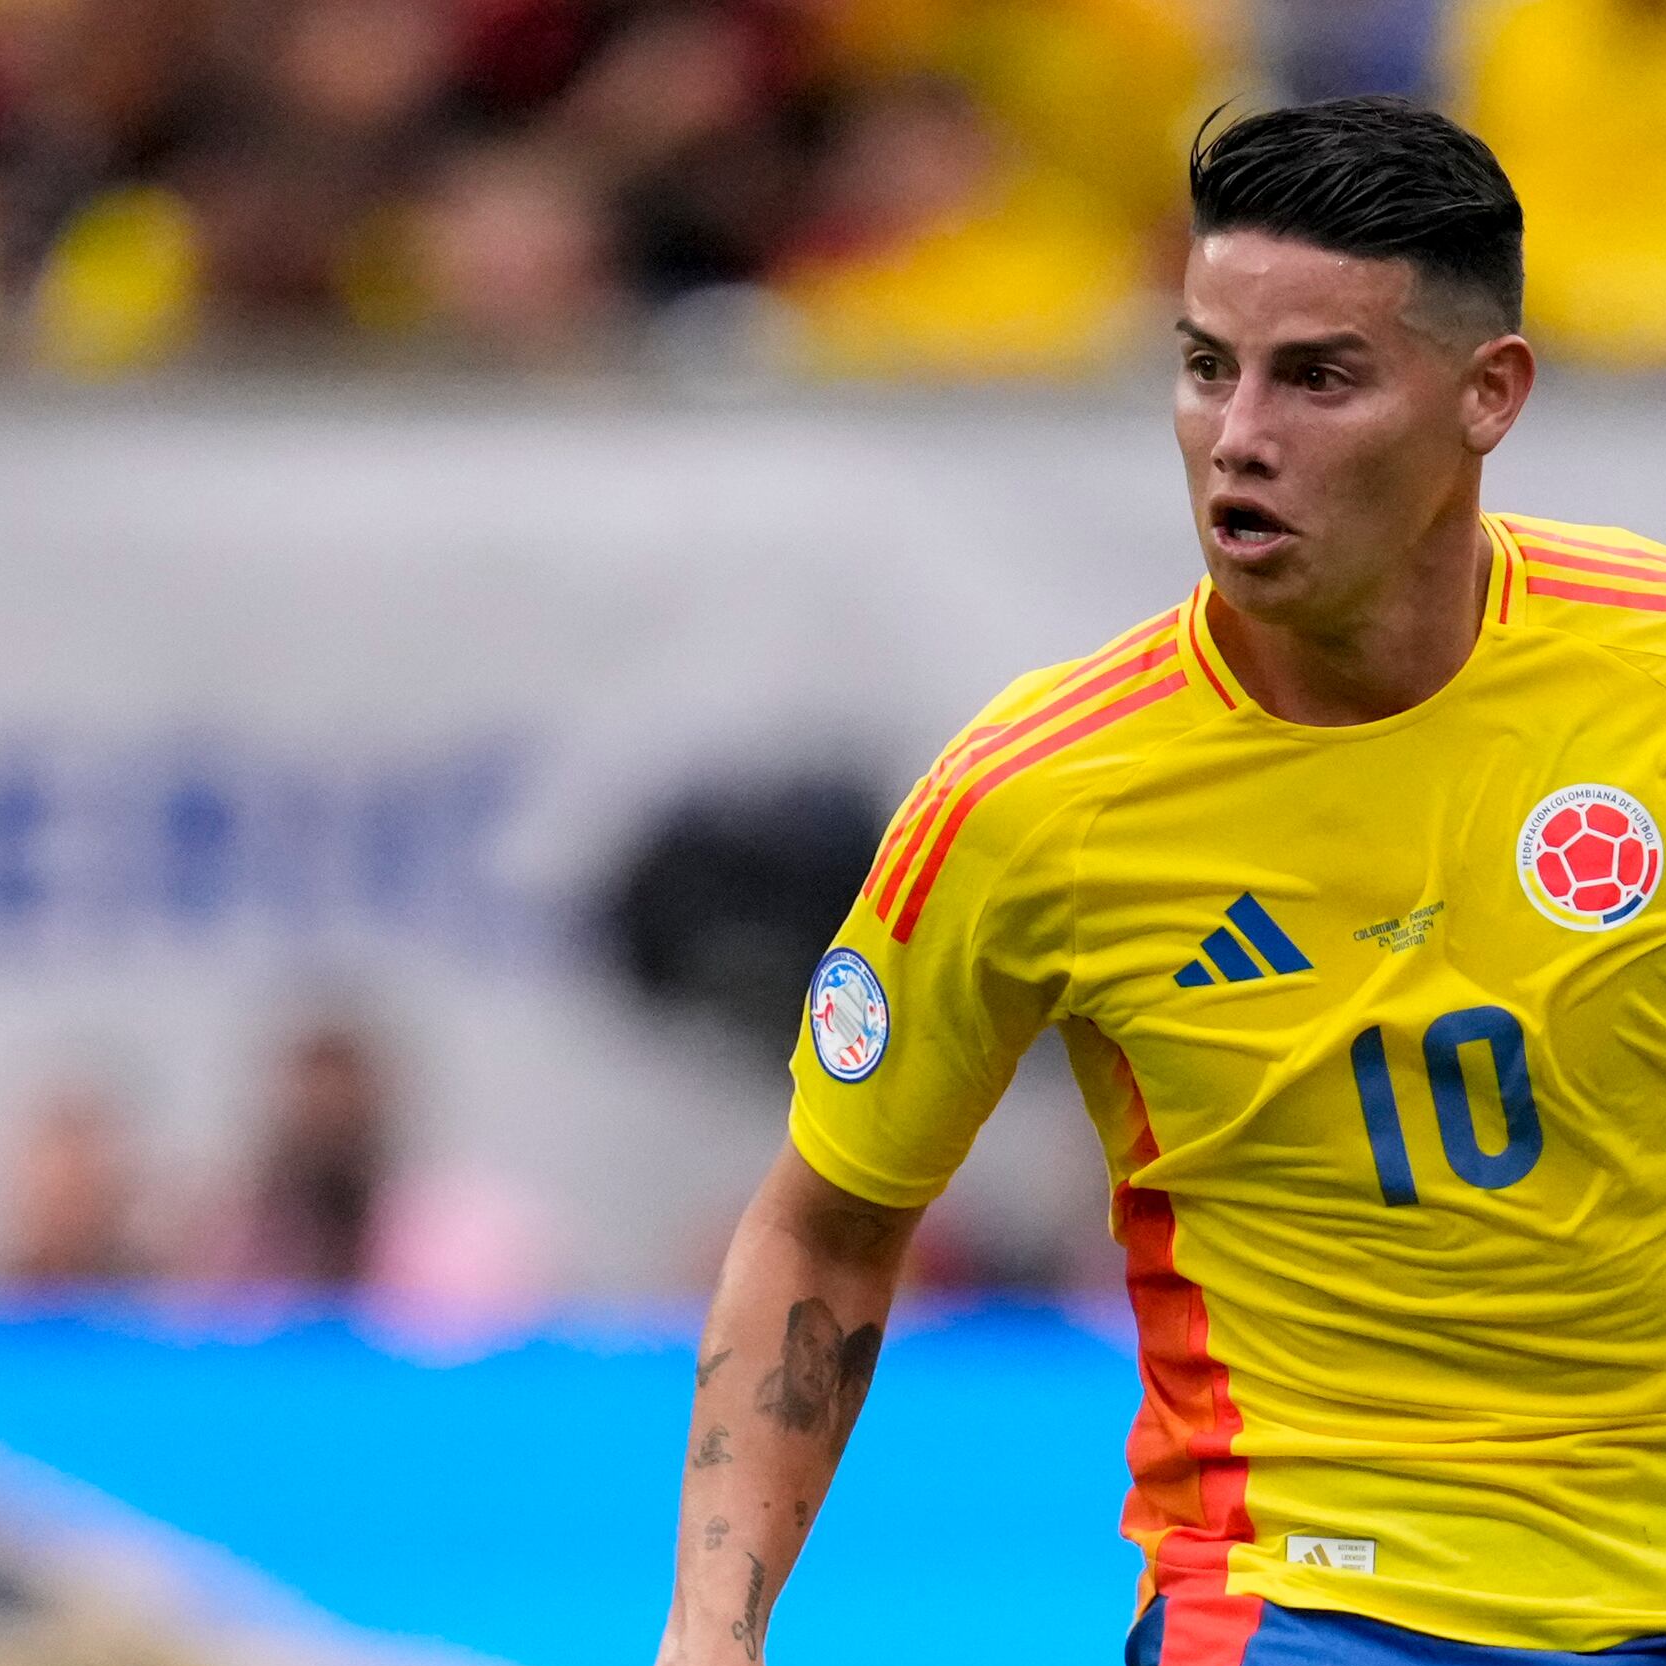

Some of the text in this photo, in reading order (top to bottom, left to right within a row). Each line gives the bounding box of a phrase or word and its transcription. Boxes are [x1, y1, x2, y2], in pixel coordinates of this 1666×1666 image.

[1550, 789, 1617, 809] COLOMBIANA
[1618, 797, 1632, 811] DE
[1630, 807, 1656, 846] FUTBOL
[1350, 1004, 1544, 1207] 10
